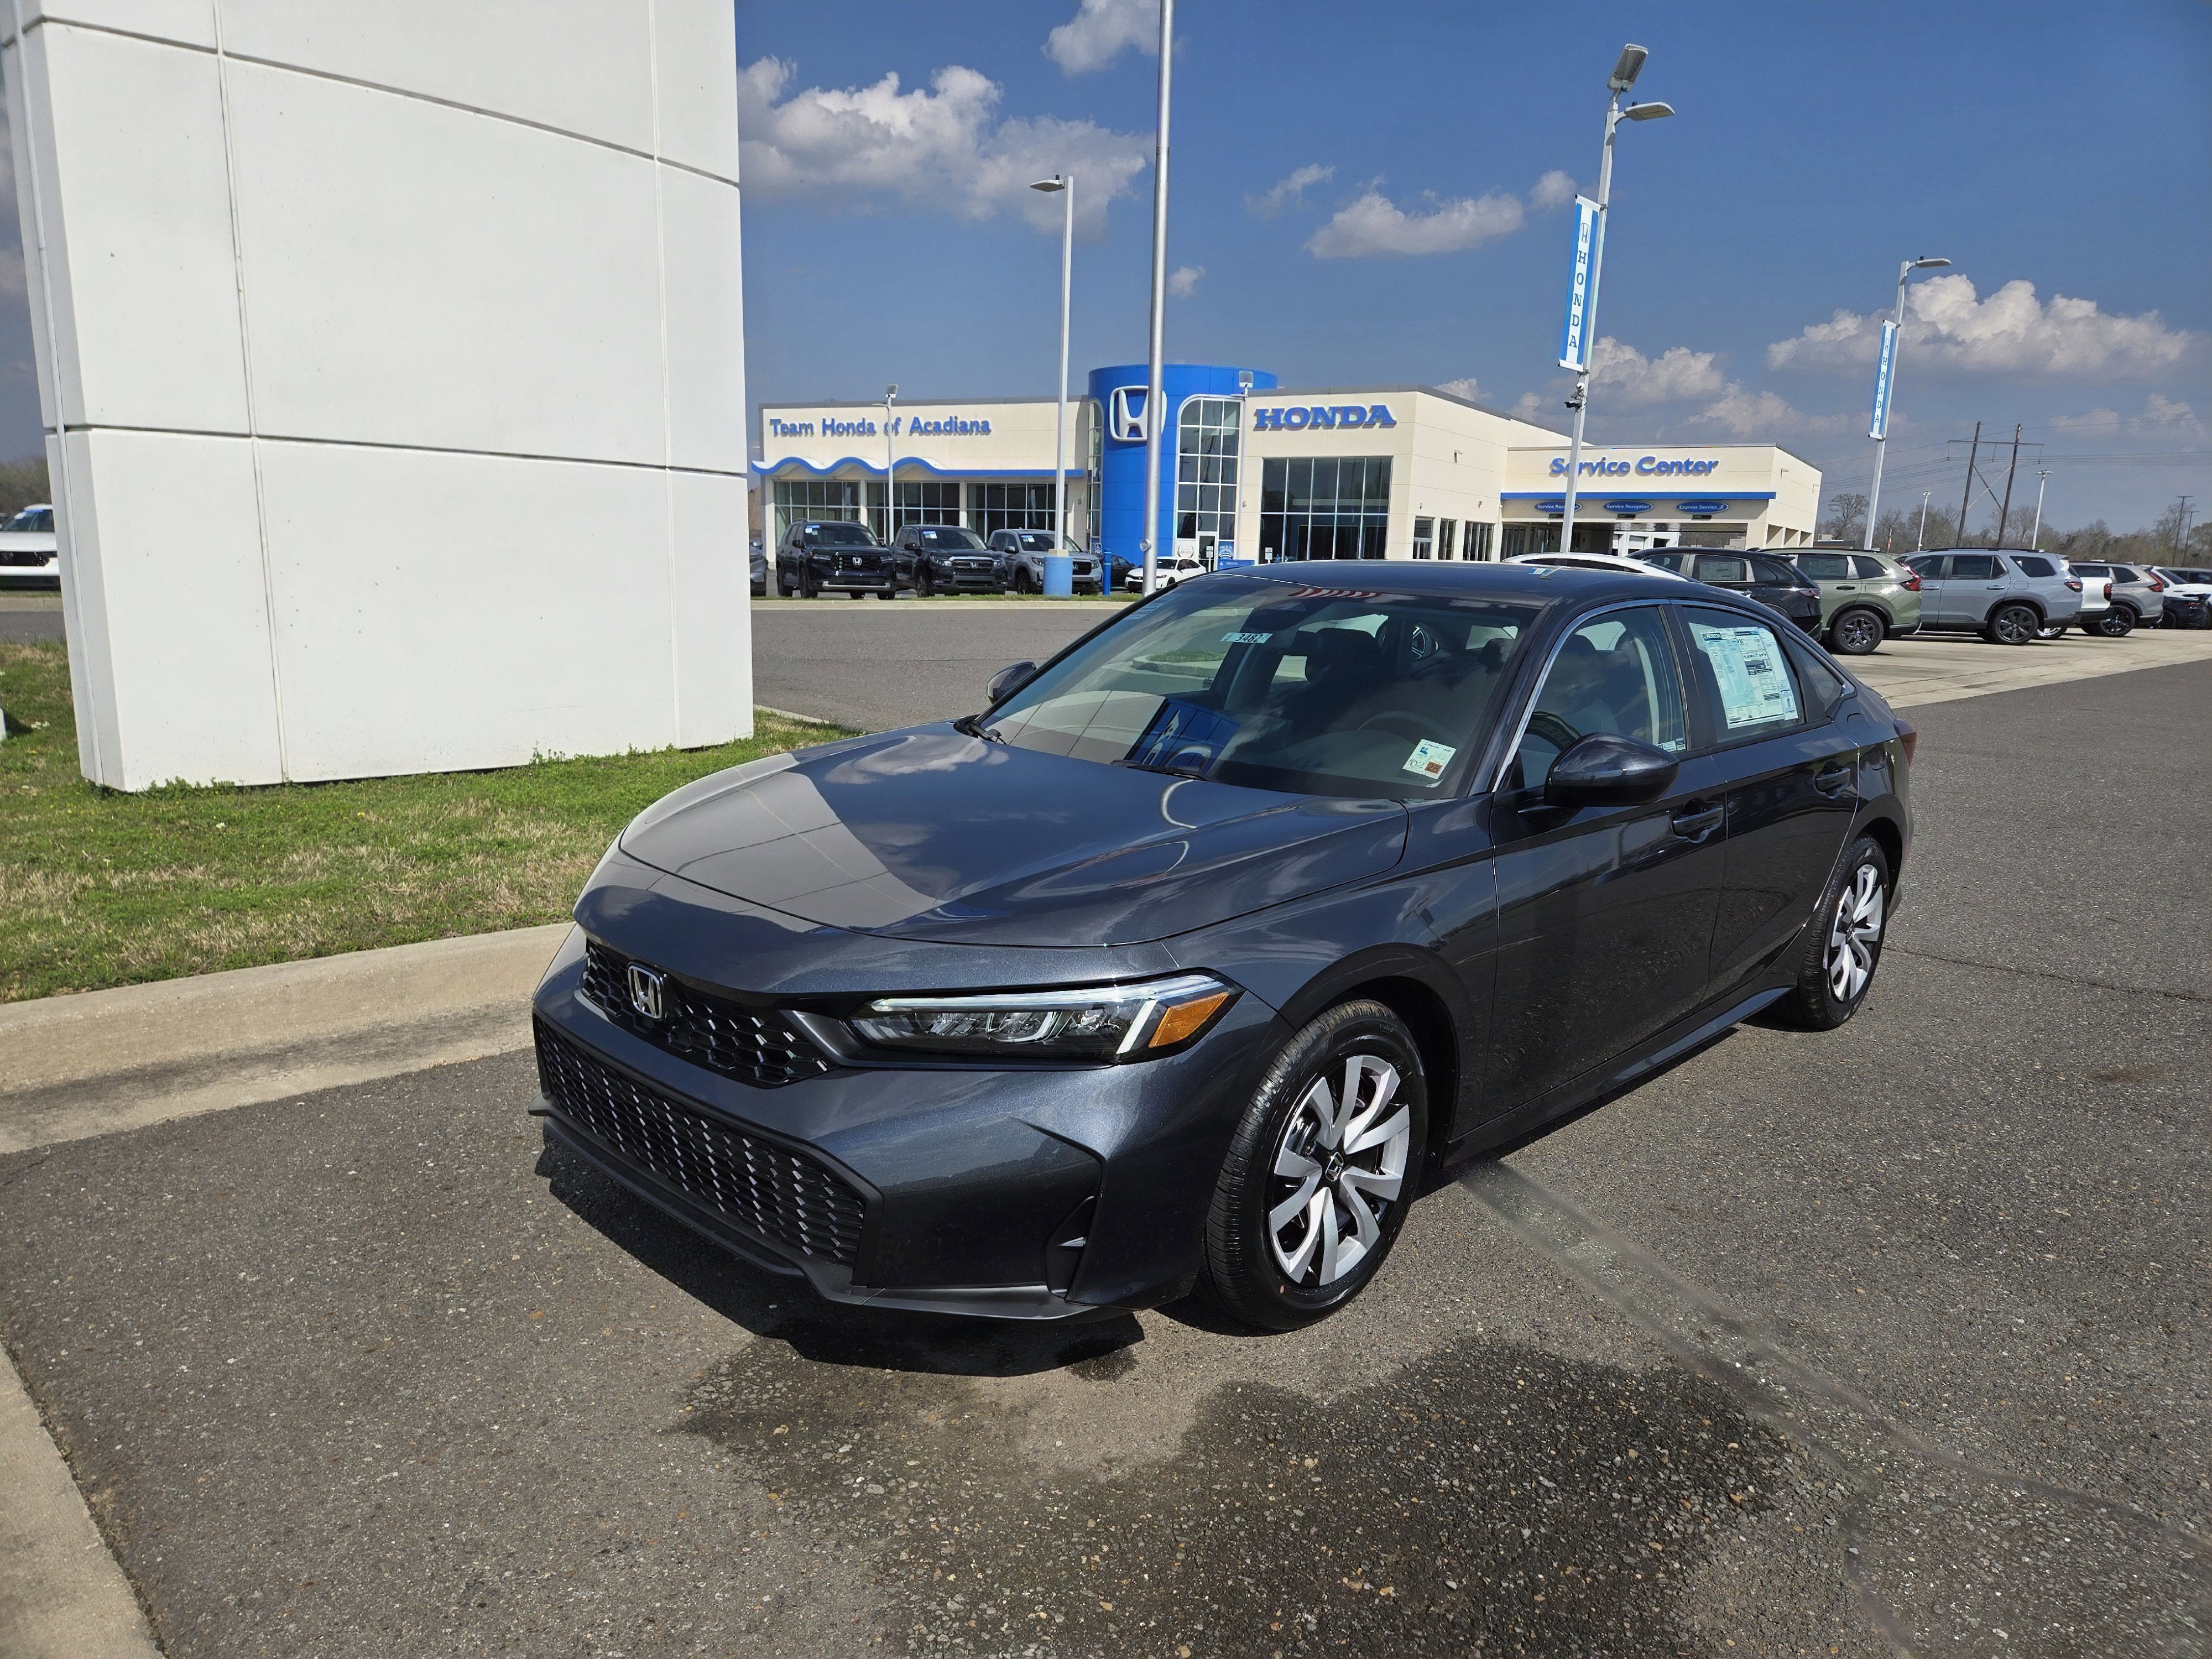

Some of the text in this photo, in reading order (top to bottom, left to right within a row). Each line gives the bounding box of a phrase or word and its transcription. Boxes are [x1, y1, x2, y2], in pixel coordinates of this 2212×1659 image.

[1569, 250, 1587, 348] HONDA
[1875, 357, 1887, 424] HONDA
[769, 415, 992, 436] Team Honda of Acadiana
[1254, 405, 1397, 430] HONDA
[1635, 456, 1719, 476] Center
[1235, 634, 1264, 643] 3482
